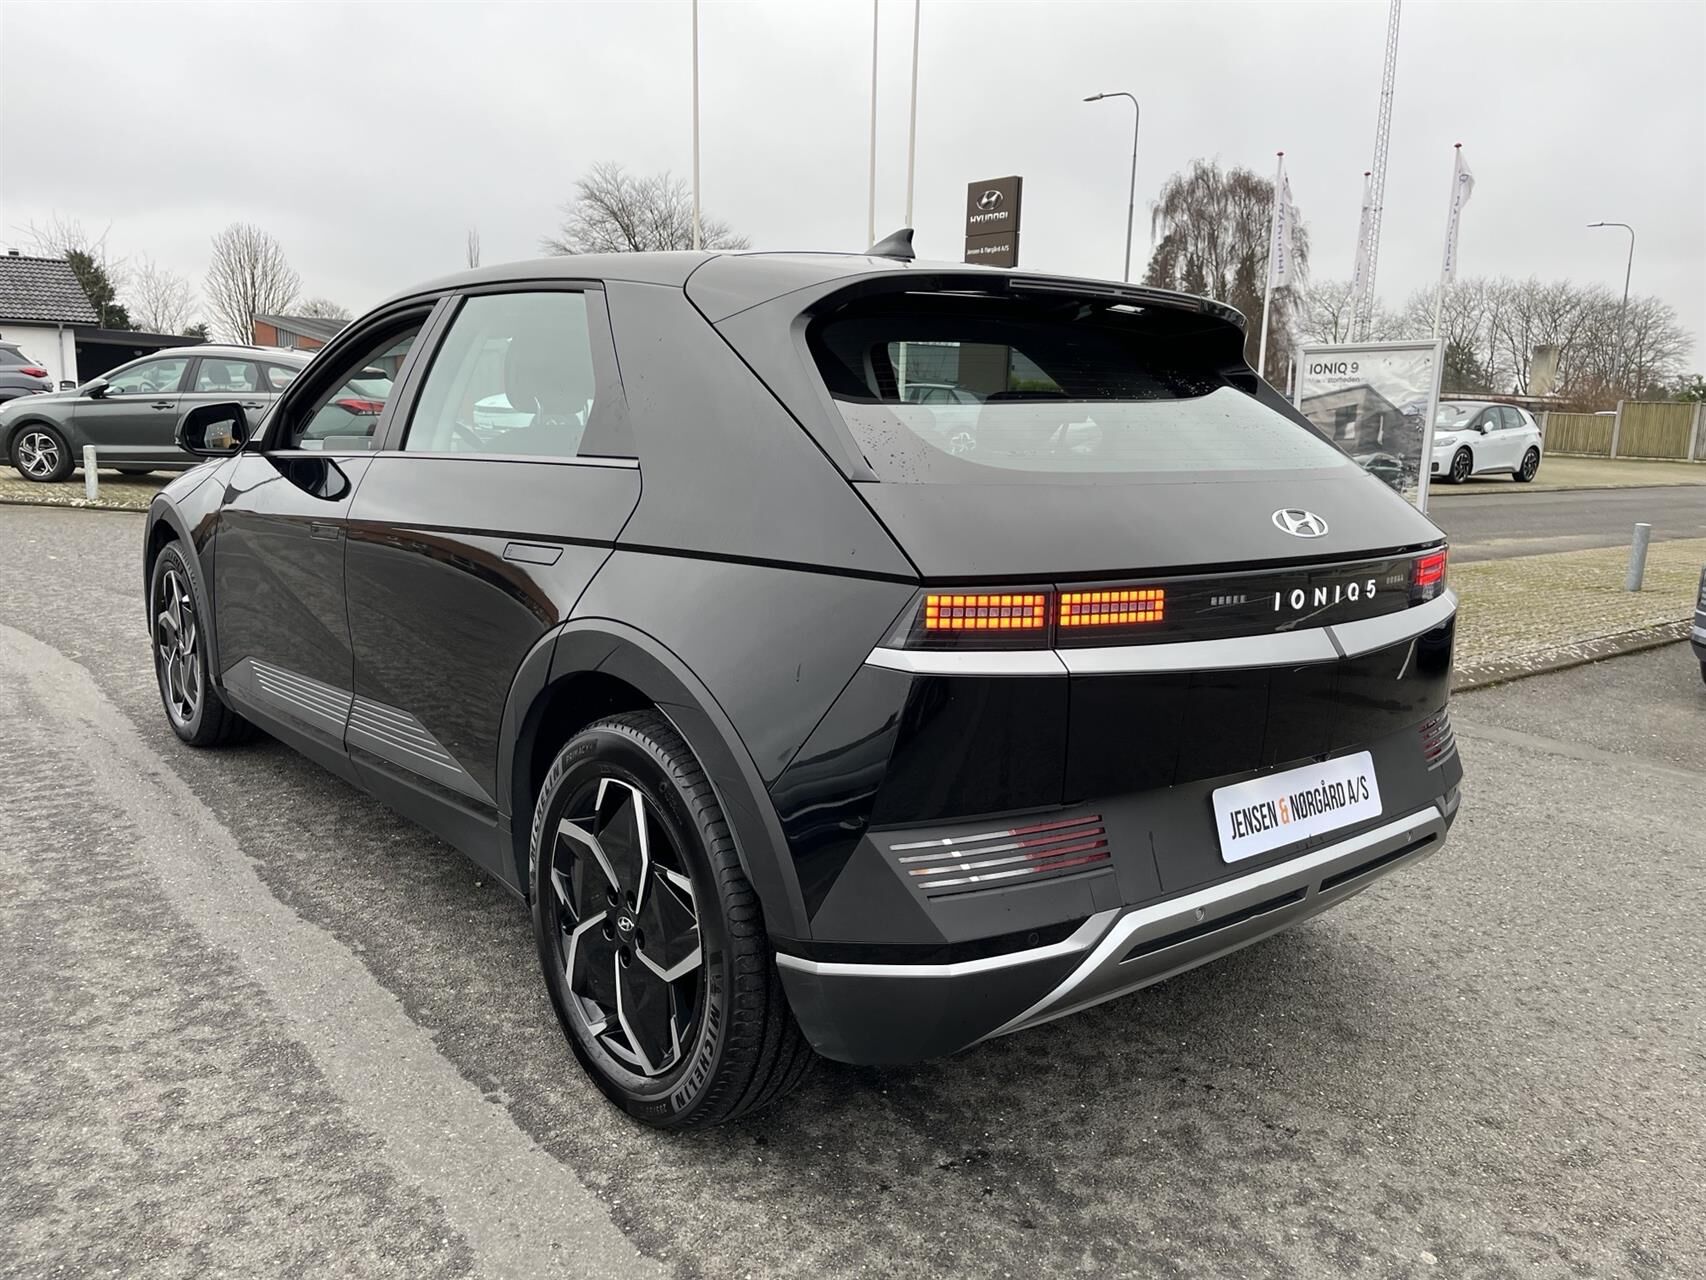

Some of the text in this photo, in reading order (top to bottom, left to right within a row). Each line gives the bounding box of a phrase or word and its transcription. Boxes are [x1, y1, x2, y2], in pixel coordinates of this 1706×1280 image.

[970, 211, 1008, 223] HYUNDAI
[1309, 361, 1359, 375] IONIQ 9
[1230, 775, 1369, 840] JENSEN & NØRGÅRD A/S
[674, 1003, 721, 1110] MICHELIN
